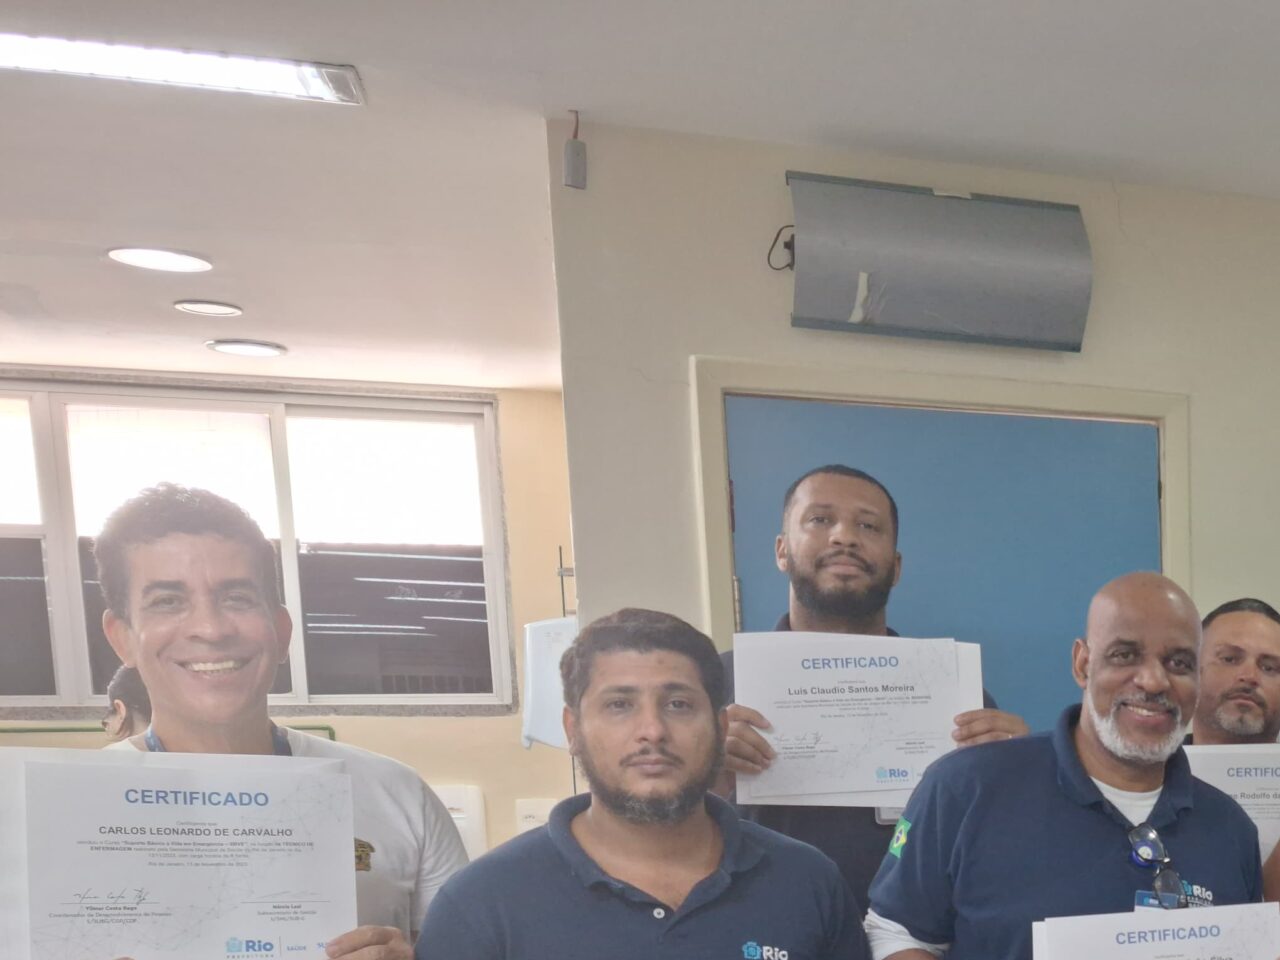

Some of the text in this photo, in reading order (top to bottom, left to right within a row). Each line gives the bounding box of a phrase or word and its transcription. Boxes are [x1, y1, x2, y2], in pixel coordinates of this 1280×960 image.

[801, 656, 899, 670] CERTIFICADO
[788, 684, 915, 696] Luis Claudio Santos Moreira
[889, 768, 909, 778] Rio
[125, 788, 269, 807] CERTIFICADO
[1240, 791, 1270, 800] Rodolfo
[99, 826, 293, 837] CARLOS LEONARDO DE CARVALHO
[1192, 885, 1213, 901] Rio
[1116, 925, 1221, 945] CERTIFICADO
[245, 940, 274, 952] Rio
[762, 946, 788, 960] Rio
